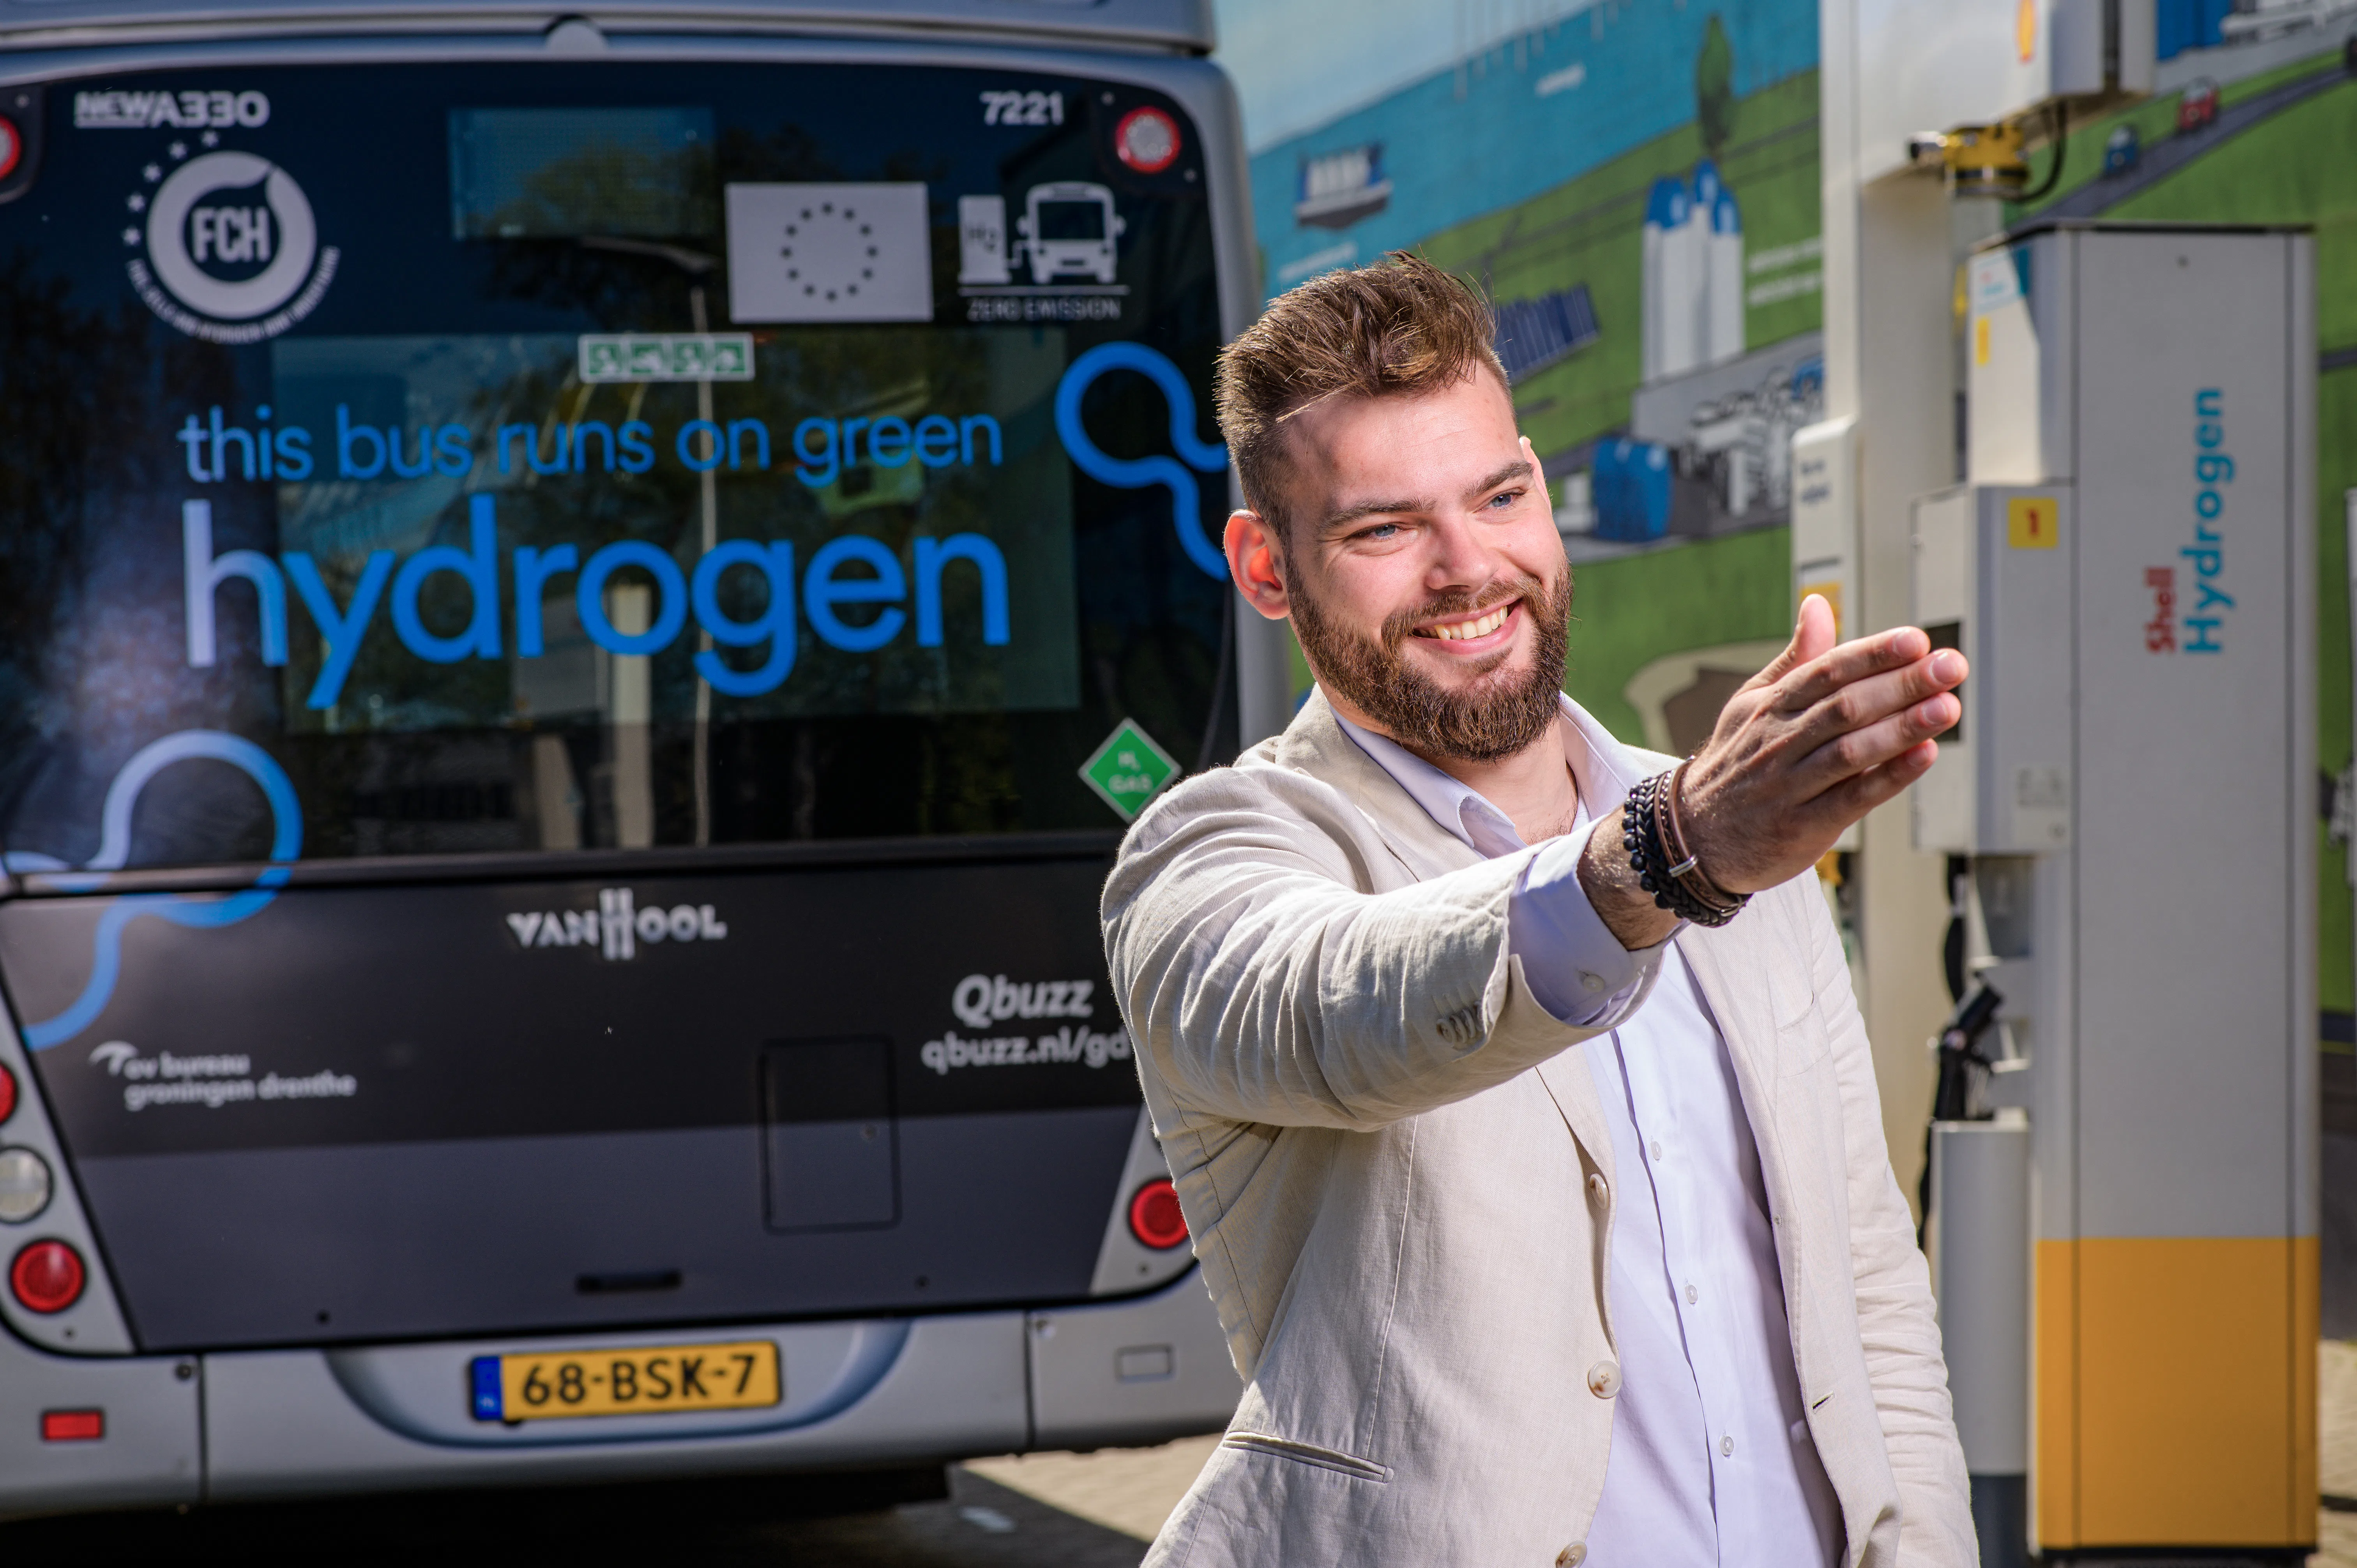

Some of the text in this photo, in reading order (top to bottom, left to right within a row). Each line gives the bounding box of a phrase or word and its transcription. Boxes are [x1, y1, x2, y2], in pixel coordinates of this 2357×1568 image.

[979, 91, 1064, 126] 7221
[191, 206, 272, 264] FCH
[966, 295, 1122, 321] ZERO EMISSION
[176, 402, 1003, 488] this bus runs on green
[2025, 507, 2040, 540] 1
[2179, 387, 2237, 655] Hydrogen
[182, 493, 1011, 710] hydrogen
[2143, 565, 2177, 655] Shell
[951, 973, 1094, 1029] Qbuzz
[158, 1051, 251, 1079] bureau
[920, 1024, 1132, 1076] qbuzz.nl/gd
[124, 1070, 357, 1112] groningen drenthe
[522, 1353, 756, 1406] 68-BSK-7
